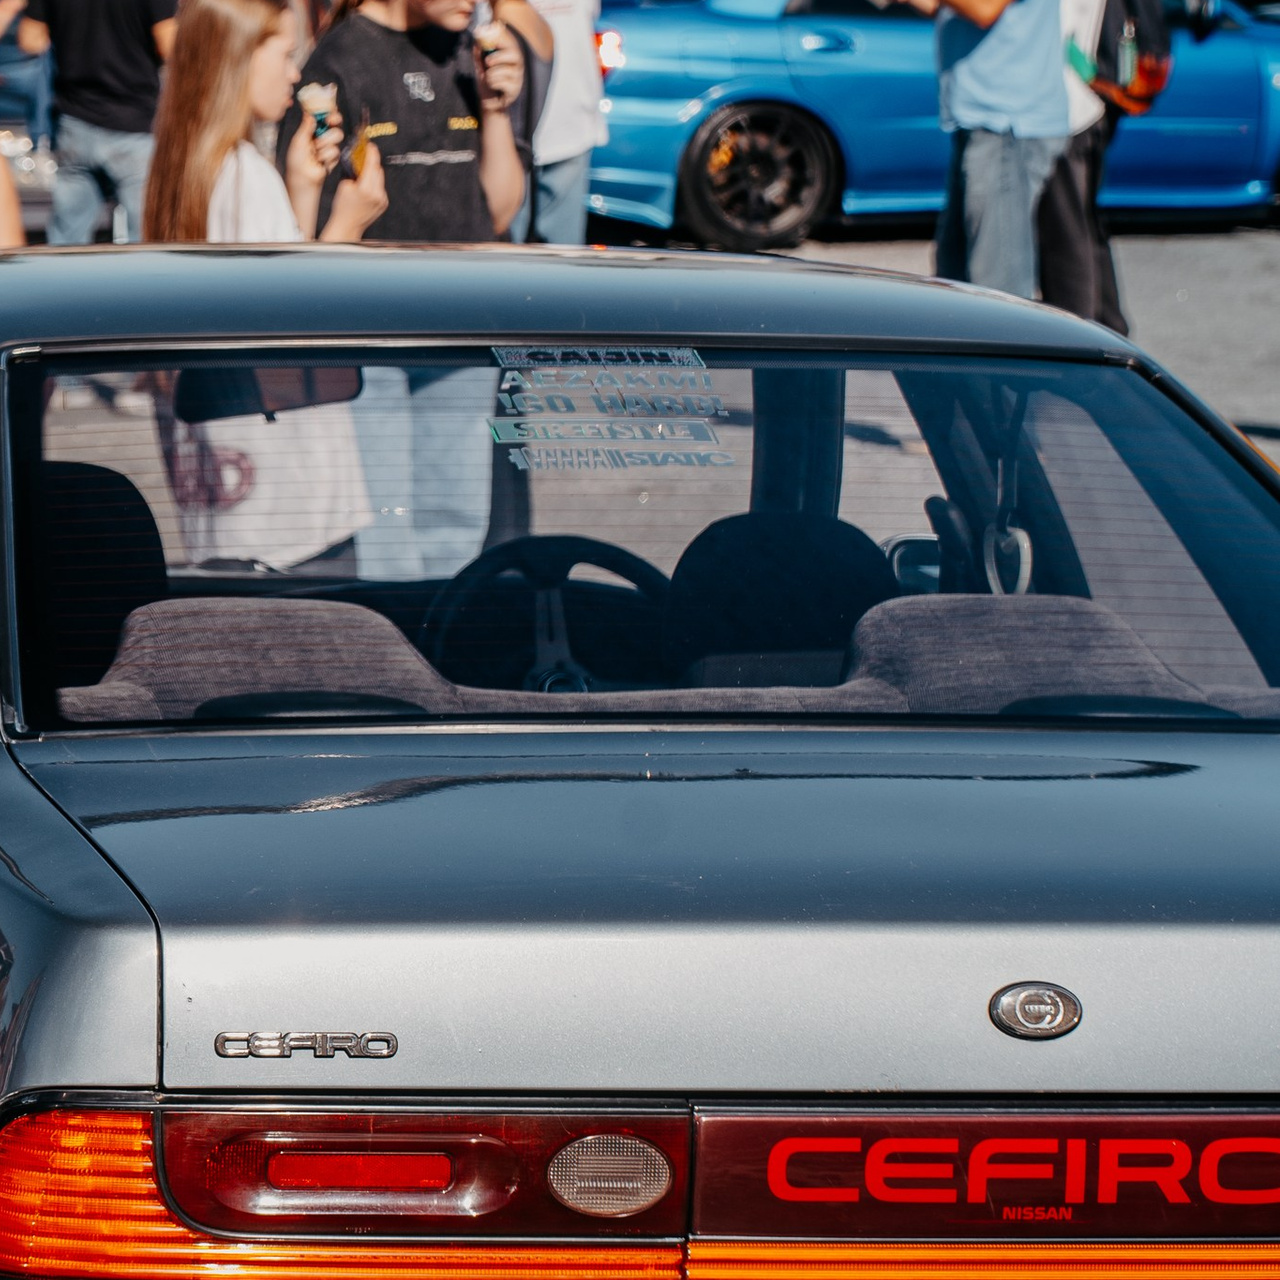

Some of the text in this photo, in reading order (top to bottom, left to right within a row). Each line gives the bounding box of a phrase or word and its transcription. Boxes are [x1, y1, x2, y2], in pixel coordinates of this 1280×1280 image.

[500, 370, 714, 390] AEZAKMI
[590, 393, 730, 417] HARD!
[513, 422, 695, 440] STREETSTYLE
[622, 450, 737, 467] STATIC
[214, 1031, 399, 1059] CEFIRO
[767, 1137, 1280, 1205] CEFIRO
[1002, 1206, 1073, 1220] NISSAN
